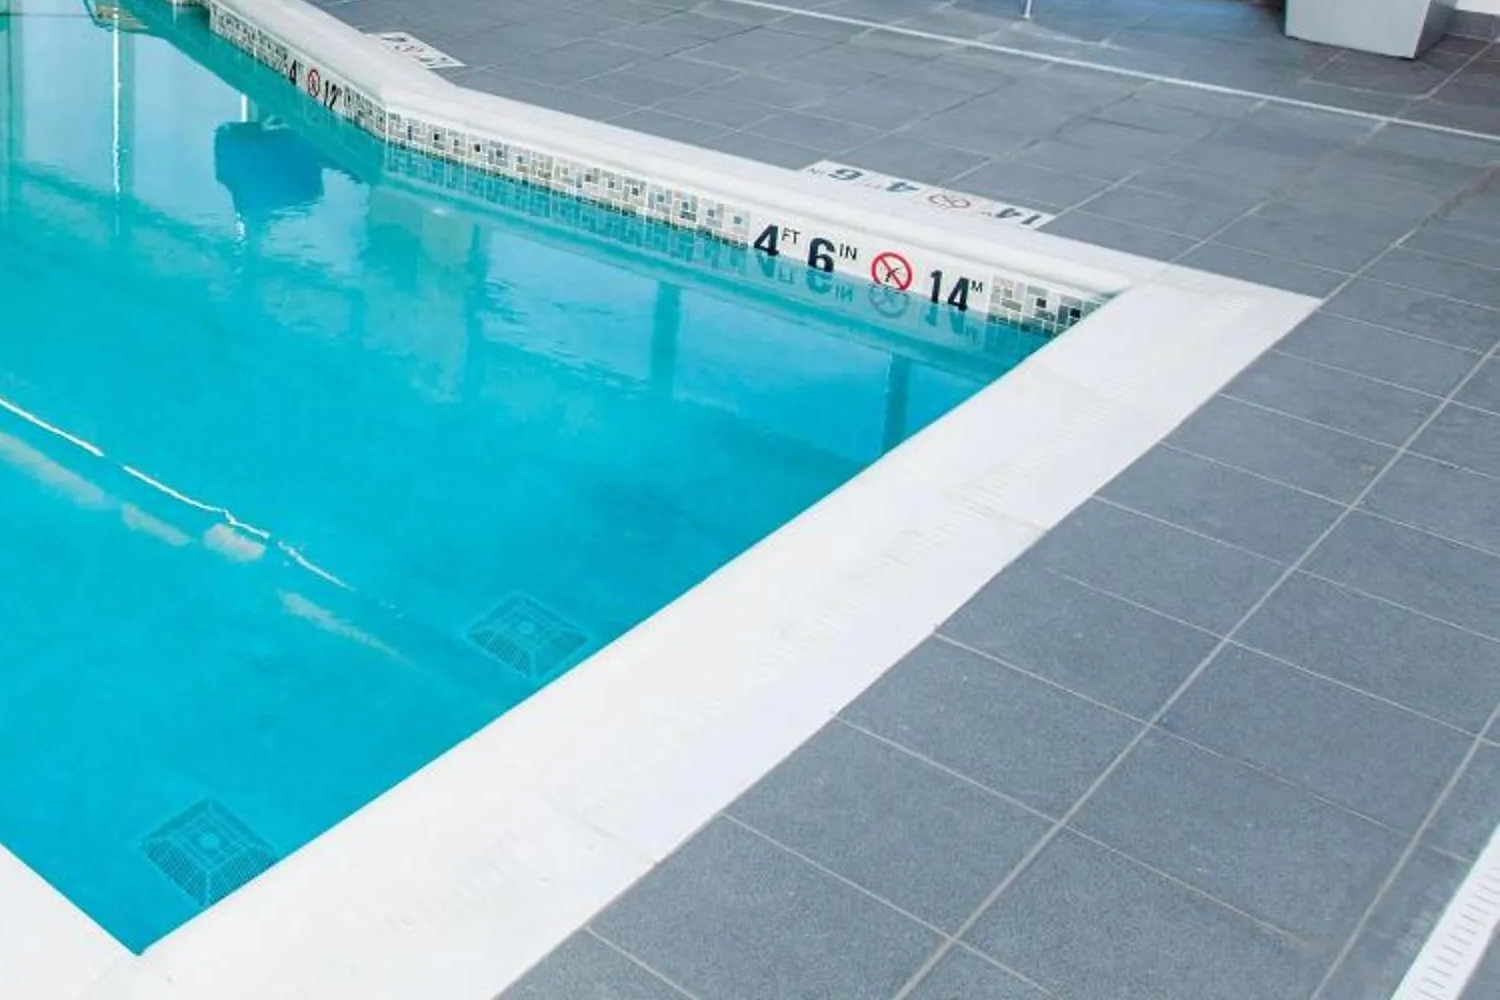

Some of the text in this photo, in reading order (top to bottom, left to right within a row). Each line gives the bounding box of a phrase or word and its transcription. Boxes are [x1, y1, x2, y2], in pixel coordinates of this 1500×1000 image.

[754, 224, 779, 256] 4
[782, 227, 800, 244] FT
[808, 237, 835, 273] 6
[839, 243, 857, 260] IN
